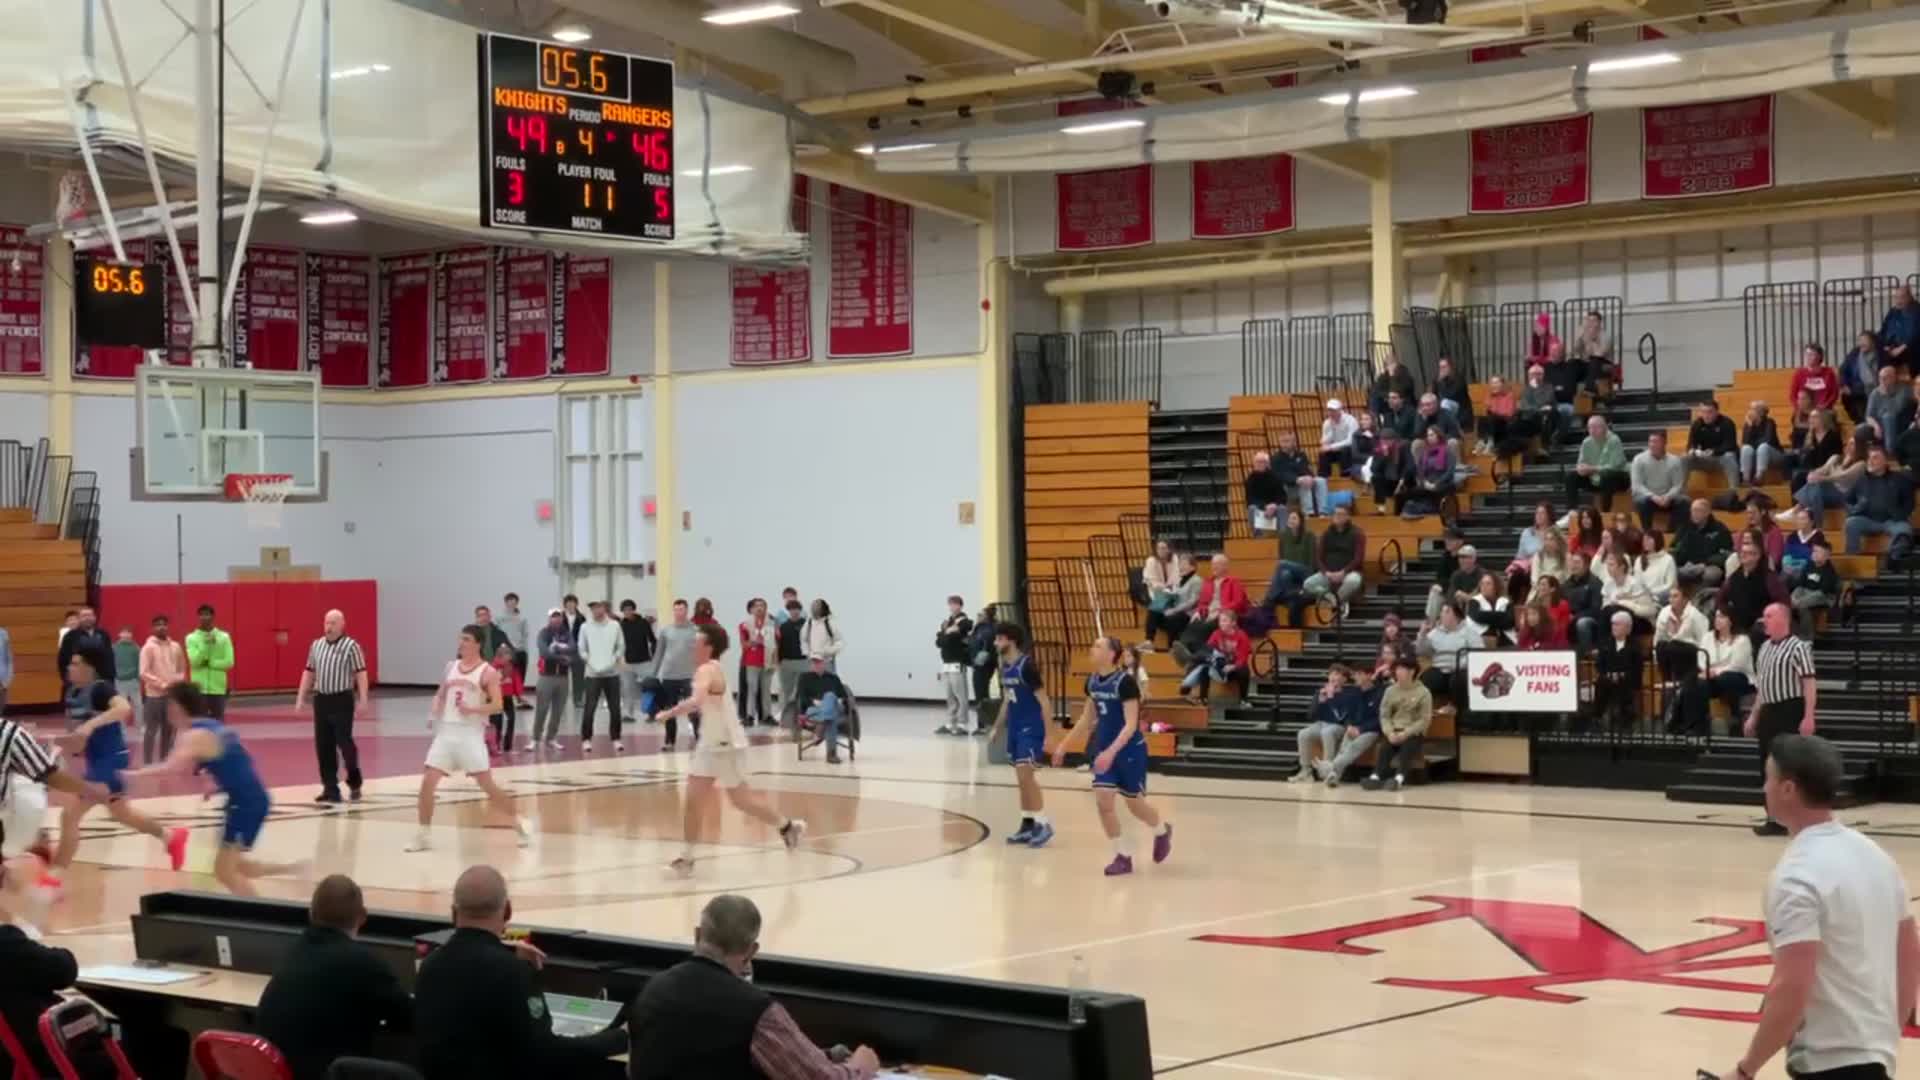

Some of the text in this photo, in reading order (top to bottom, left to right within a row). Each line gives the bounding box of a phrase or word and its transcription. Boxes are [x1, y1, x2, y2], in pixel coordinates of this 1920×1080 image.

[542, 47, 607, 93] 05.6
[495, 87, 568, 115] KNIGHTS
[568, 108, 601, 124] PERIOD
[602, 102, 672, 129] RANGERS
[507, 115, 548, 154] 49
[579, 128, 594, 155] 4
[495, 156, 526, 171] FOULS
[632, 131, 669, 171] 46
[558, 163, 617, 182] PLAYER FOUL
[643, 173, 671, 187] FOULS
[508, 171, 525, 205] 3
[495, 209, 526, 223] SCORE
[654, 188, 669, 219] 5
[571, 216, 602, 230] MATCH
[644, 224, 672, 236] SCORE
[93, 265, 145, 295] 05.6
[554, 263, 564, 320] VOLLEYBALL
[235, 270, 248, 355] SOFTBALL
[308, 325, 320, 360] BOYS
[1516, 664, 1570, 677] VISITING
[1526, 681, 1561, 693] FANS
